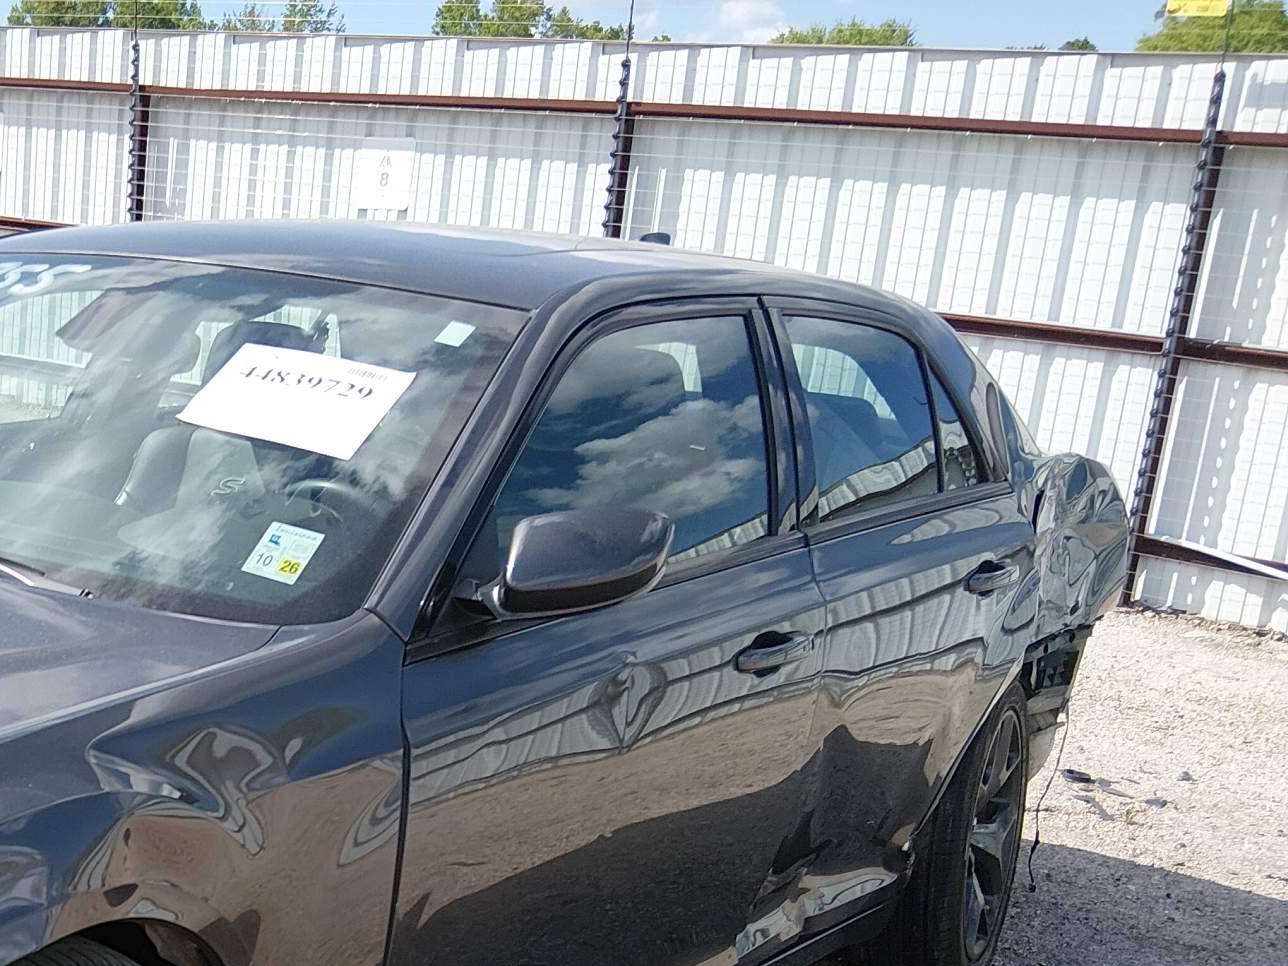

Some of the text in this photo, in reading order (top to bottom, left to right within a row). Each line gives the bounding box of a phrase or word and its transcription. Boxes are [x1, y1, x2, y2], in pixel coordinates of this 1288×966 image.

[379, 171, 390, 187] 8
[239, 365, 374, 400] 44839729
[255, 552, 273, 568] 10
[279, 559, 301, 575] 26
